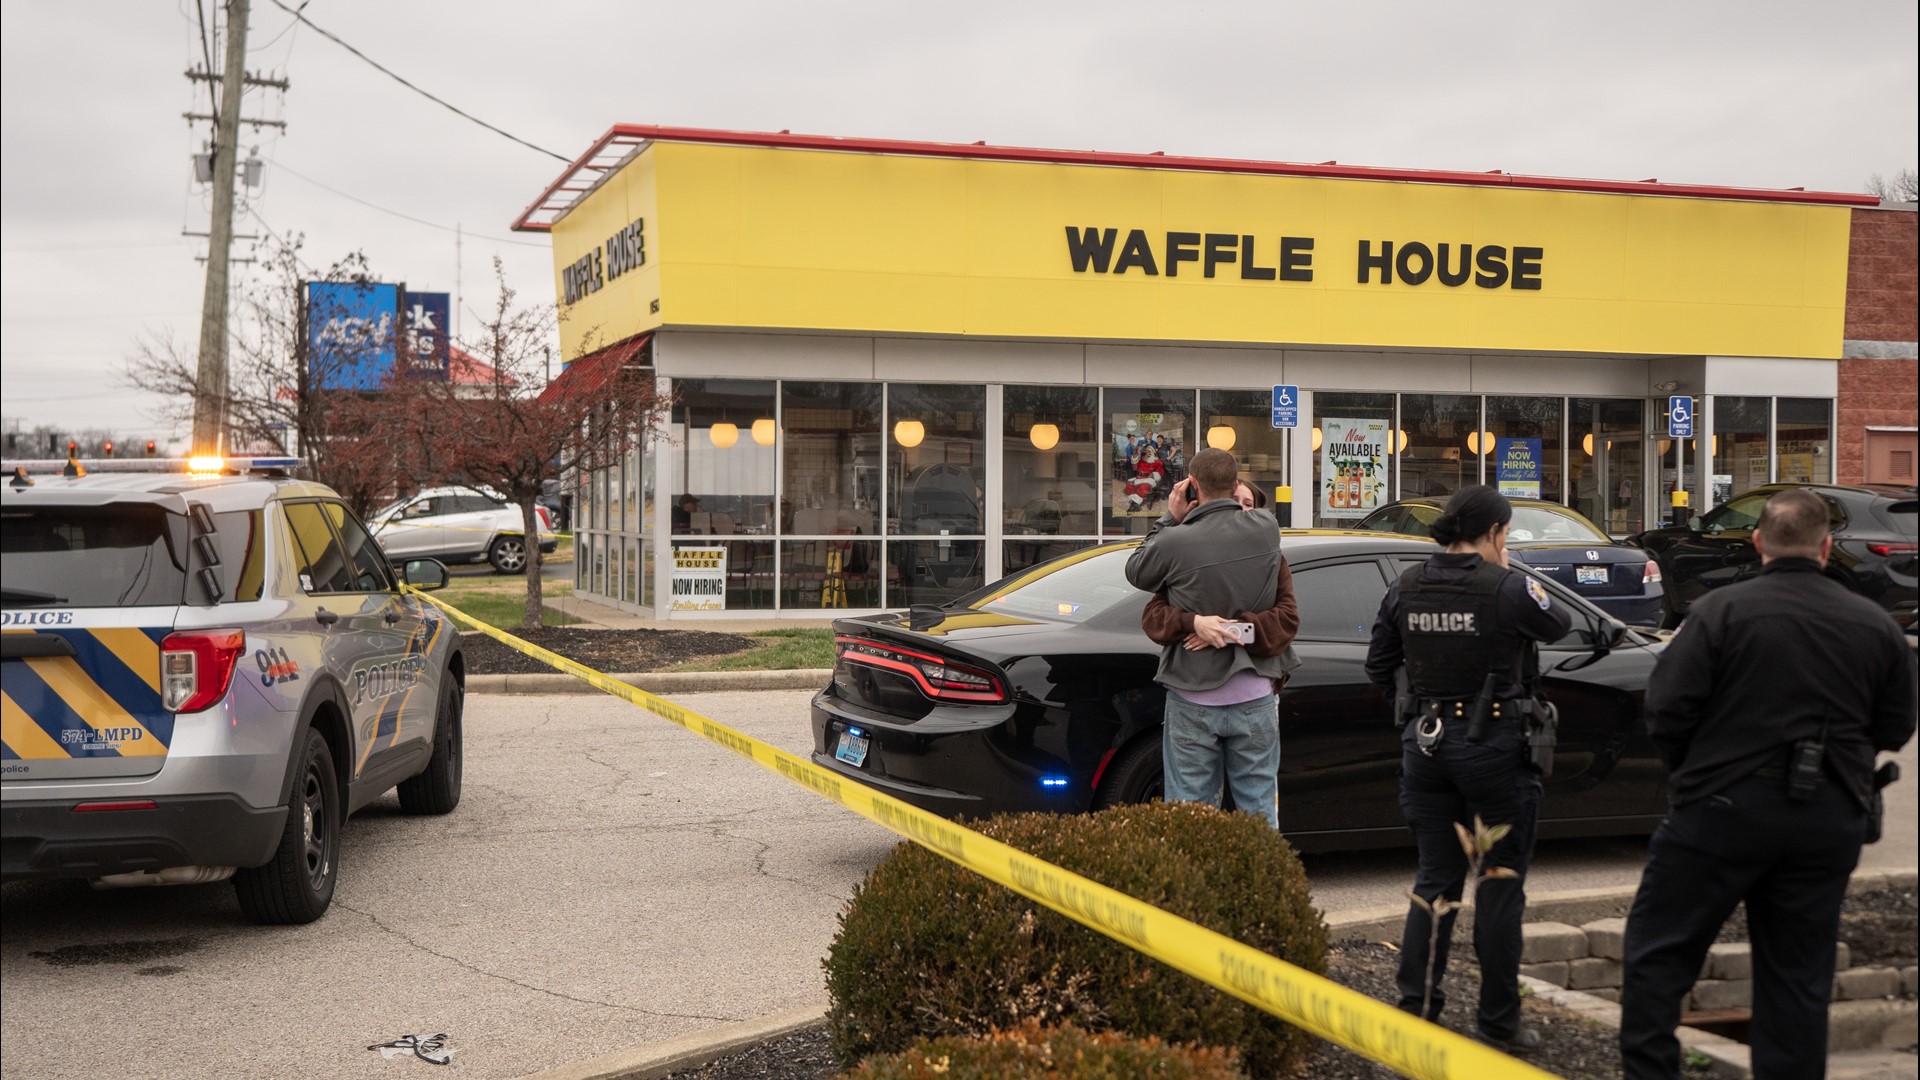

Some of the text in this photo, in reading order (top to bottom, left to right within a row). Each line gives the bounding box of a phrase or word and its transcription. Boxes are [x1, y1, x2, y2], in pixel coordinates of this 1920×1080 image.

[562, 217, 646, 306] WAFFLE HOUSE
[1065, 226, 1544, 291] WAFFLE HOUSE
[1344, 428, 1366, 442] Now
[1329, 443, 1381, 458] AVAILABLE
[1507, 451, 1531, 460] NOW
[1502, 460, 1536, 469] HIRING
[1501, 470, 1538, 481] Friendly Folks
[673, 551, 723, 559] WAFFLE
[676, 560, 718, 568] HOUSE
[672, 578, 722, 596] NOW HIRING
[1407, 612, 1476, 632] POLICE
[849, 644, 904, 661] DODGE
[255, 647, 300, 688] 911
[354, 655, 419, 707] POLICE
[61, 727, 144, 744] 574-LMPD
